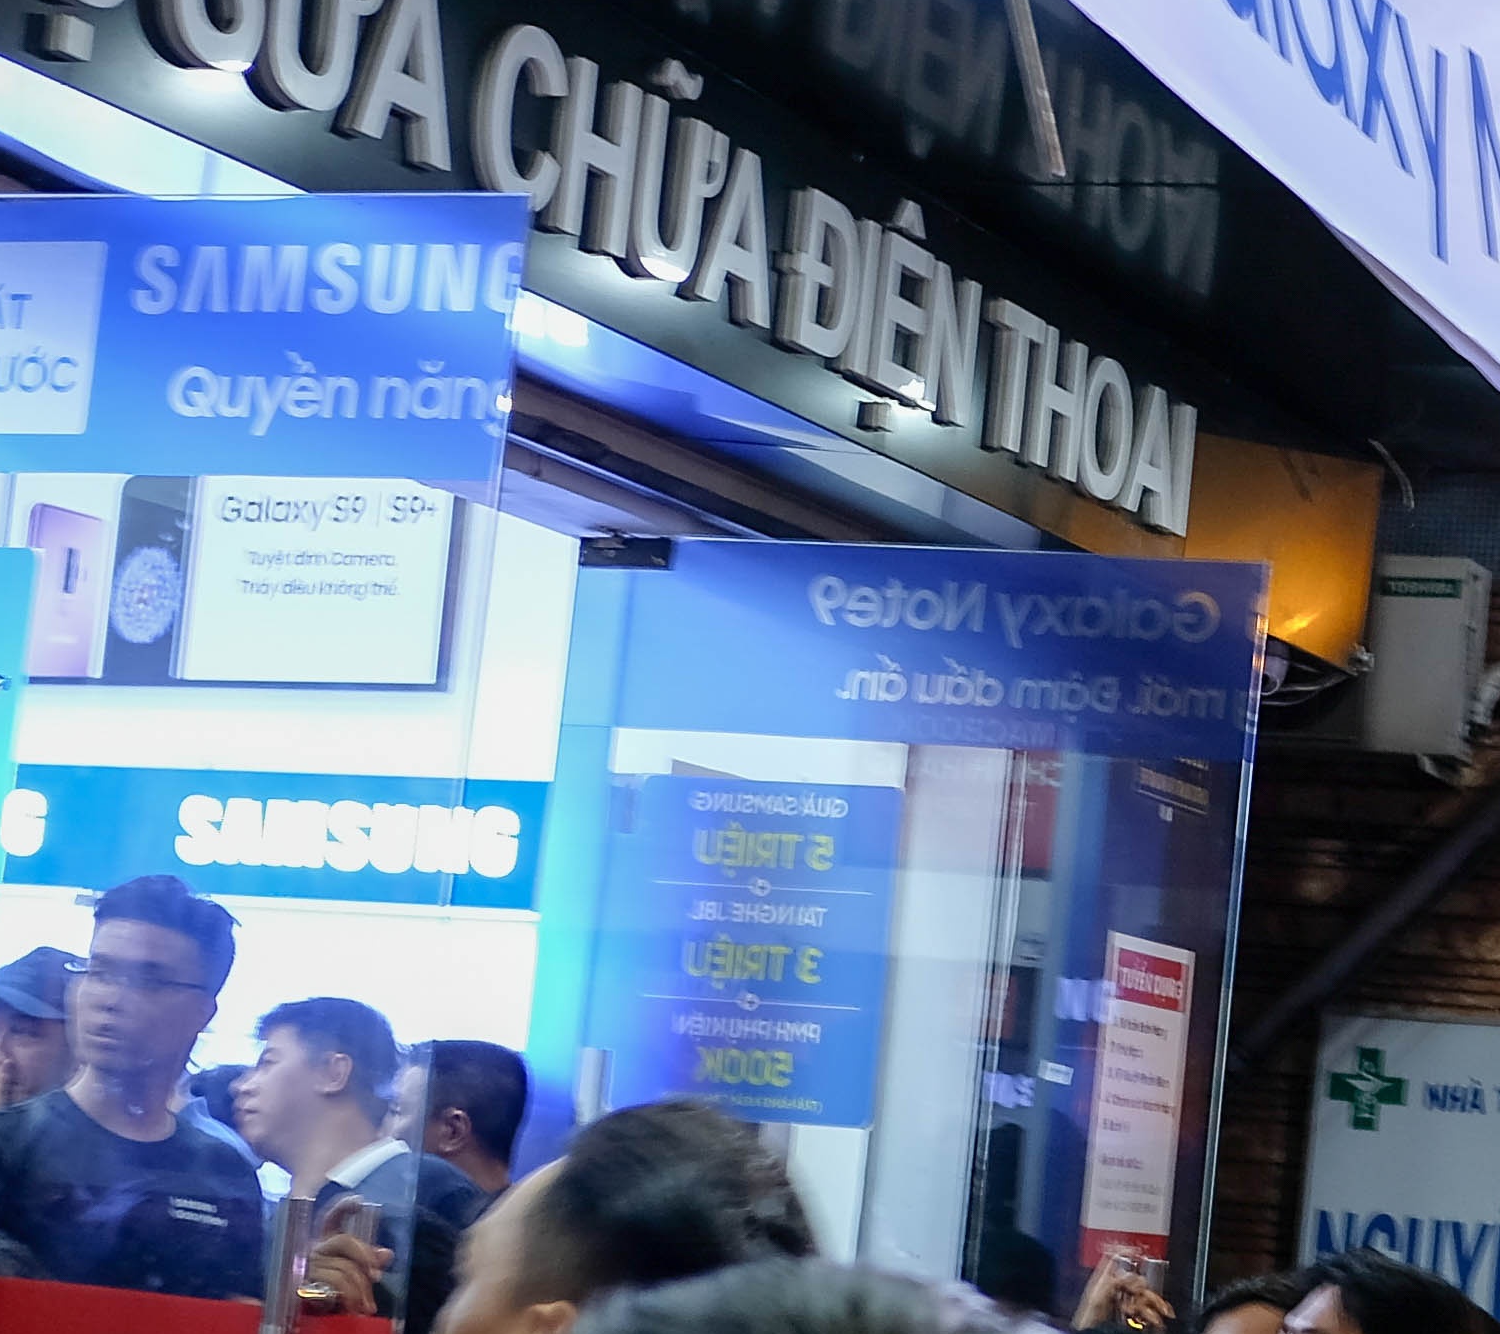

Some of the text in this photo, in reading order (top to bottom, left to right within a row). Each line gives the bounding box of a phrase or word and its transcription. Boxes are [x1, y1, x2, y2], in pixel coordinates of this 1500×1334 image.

[470, 23, 772, 330] CHỮA
[777, 186, 983, 433] ĐIỆN
[131, 243, 522, 315] SAMSUNG
[167, 349, 357, 436] Quyền
[220, 494, 439, 531] Galaxy S9 S9+
[175, 795, 521, 879] SAMSUNG
[1422, 1075, 1488, 1117] NHÀ
